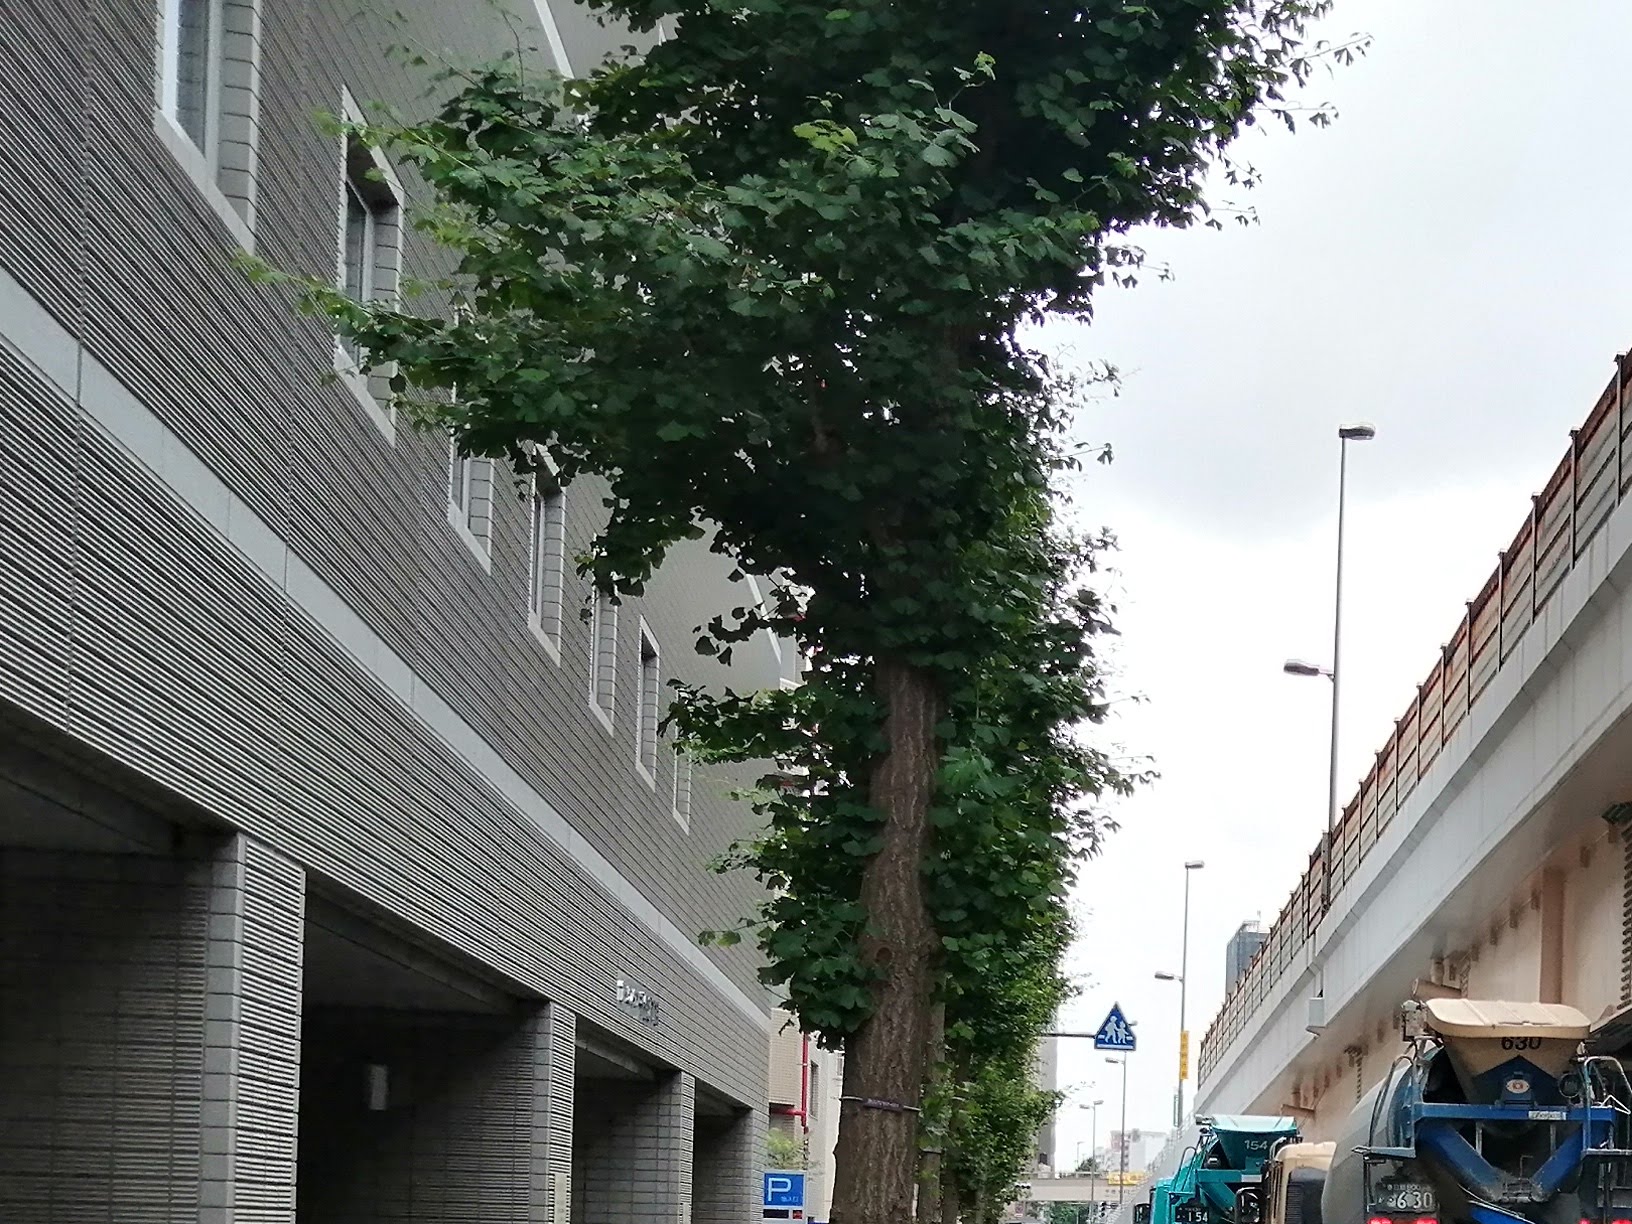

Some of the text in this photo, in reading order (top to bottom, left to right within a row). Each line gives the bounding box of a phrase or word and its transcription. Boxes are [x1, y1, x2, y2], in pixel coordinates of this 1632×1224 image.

[1501, 1037, 1541, 1050] 630
[1244, 1140, 1268, 1150] 154
[768, 1177, 792, 1202] P
[1188, 1211, 1208, 1222] 154
